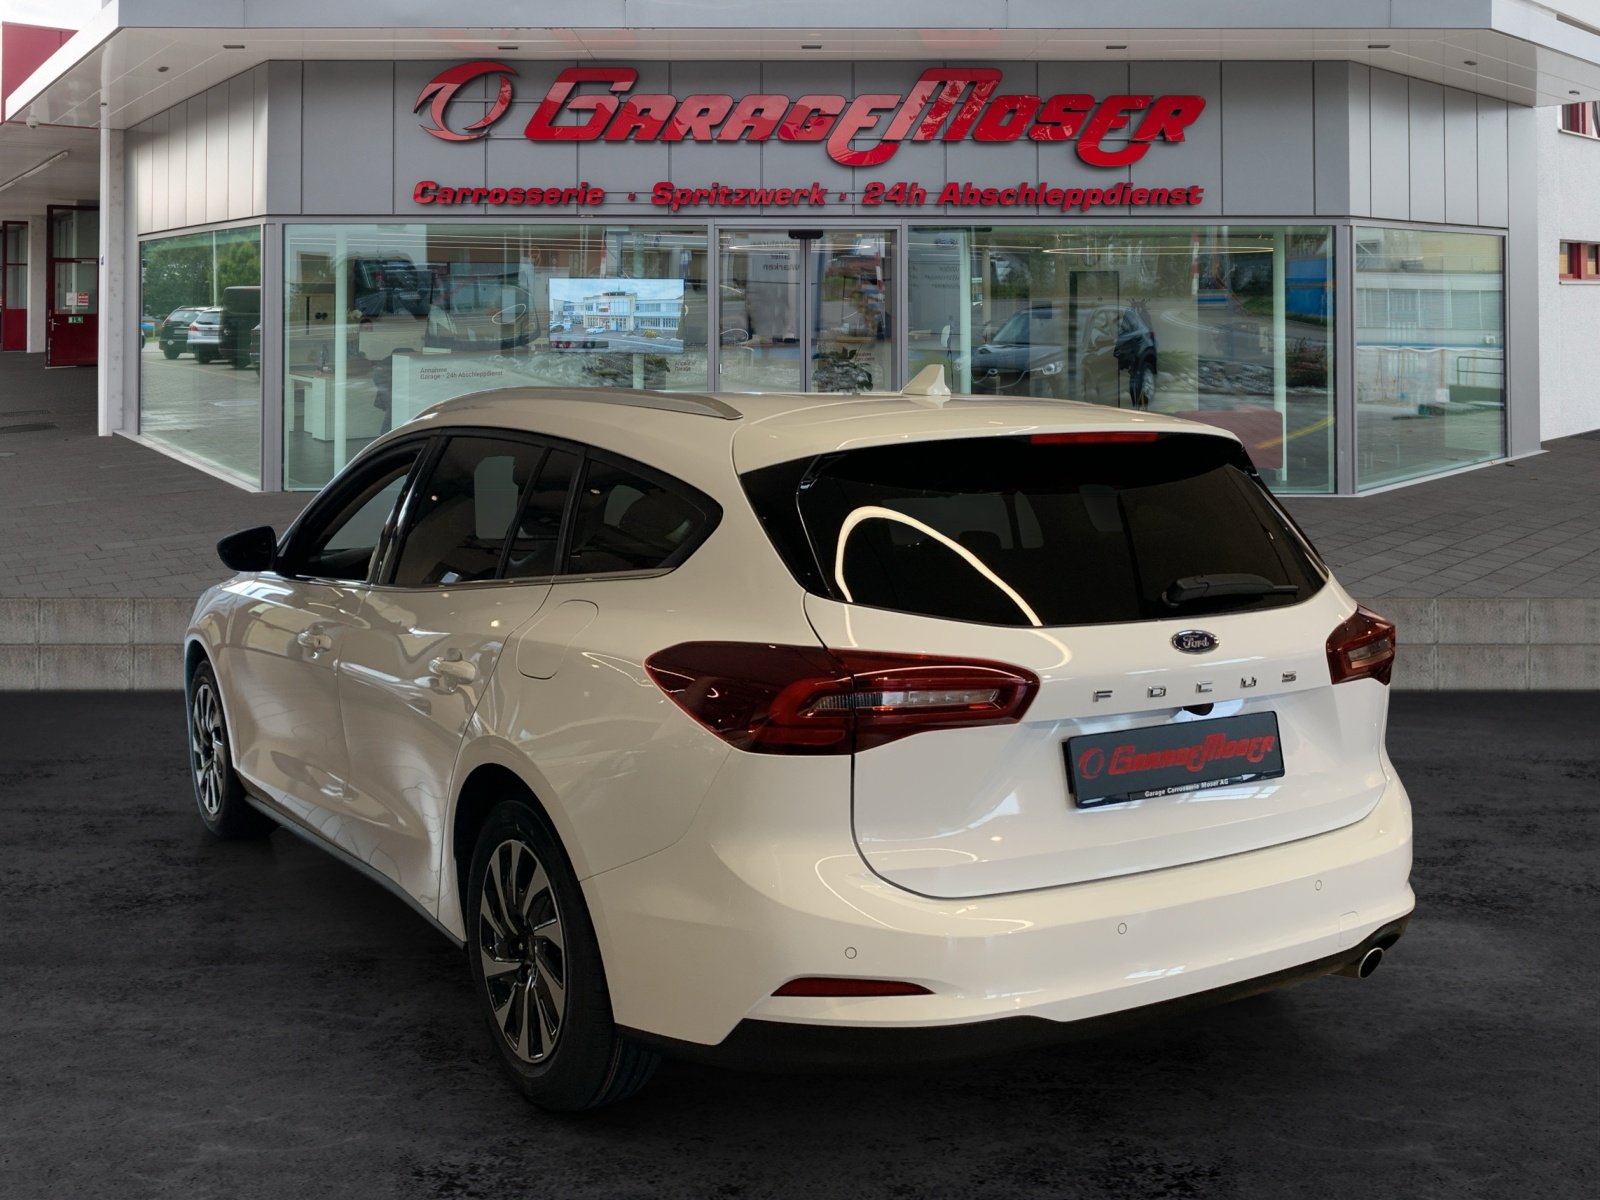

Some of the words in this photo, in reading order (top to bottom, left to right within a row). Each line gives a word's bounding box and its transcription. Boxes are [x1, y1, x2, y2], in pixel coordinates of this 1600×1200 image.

[413, 181, 605, 206] Carrosserie
[651, 181, 826, 212] Spritzwerk
[862, 181, 927, 206] 24h
[937, 181, 1204, 213] Abschleppdienst
[1182, 634, 1210, 649] Ford
[1093, 671, 1297, 703] FOCUS
[1144, 789, 1166, 798] Garage
[1167, 784, 1200, 794] Carrosserie
